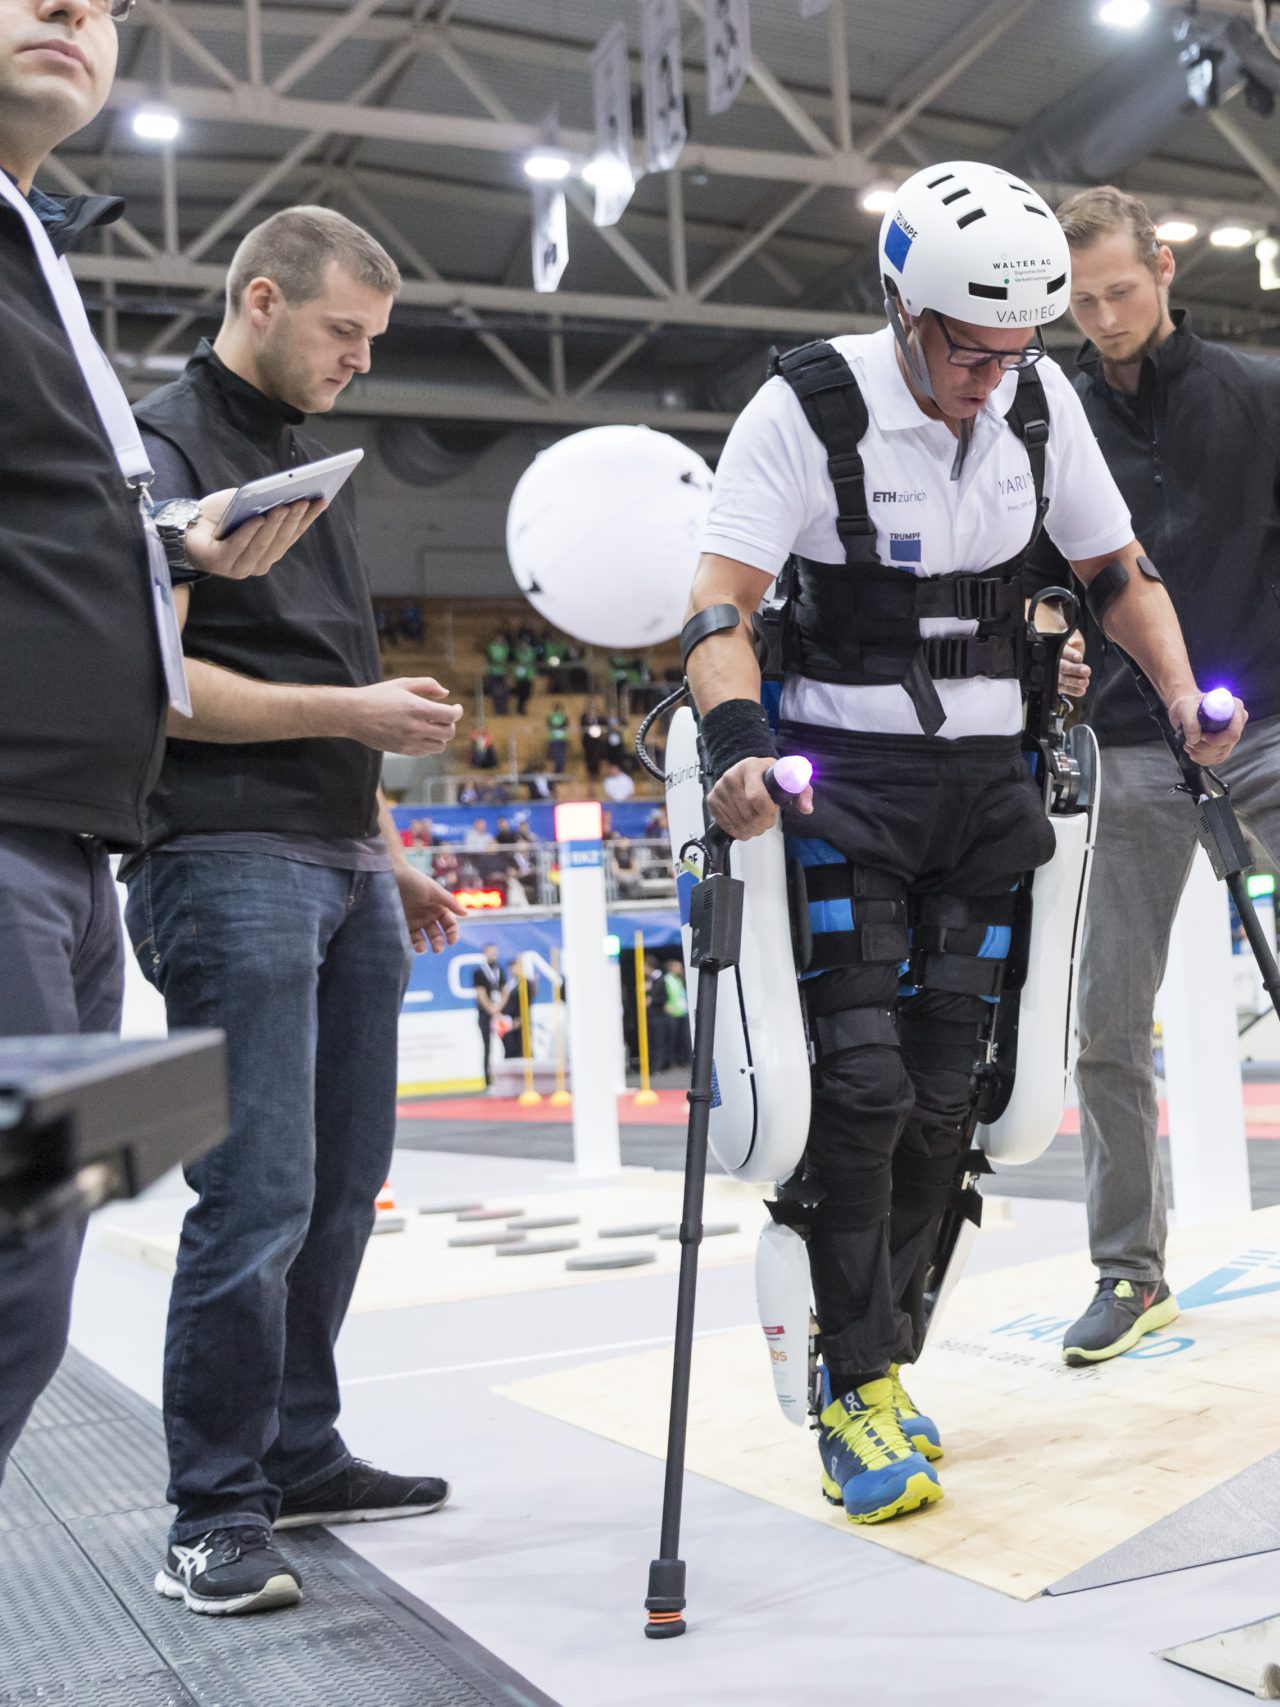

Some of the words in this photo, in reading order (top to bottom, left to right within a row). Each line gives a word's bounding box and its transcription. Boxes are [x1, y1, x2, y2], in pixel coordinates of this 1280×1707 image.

[896, 209, 918, 240] TRUMPF
[993, 260, 1036, 270] WALTER
[890, 532, 921, 540] TRUMPF
[991, 1313, 1196, 1359] VAD
